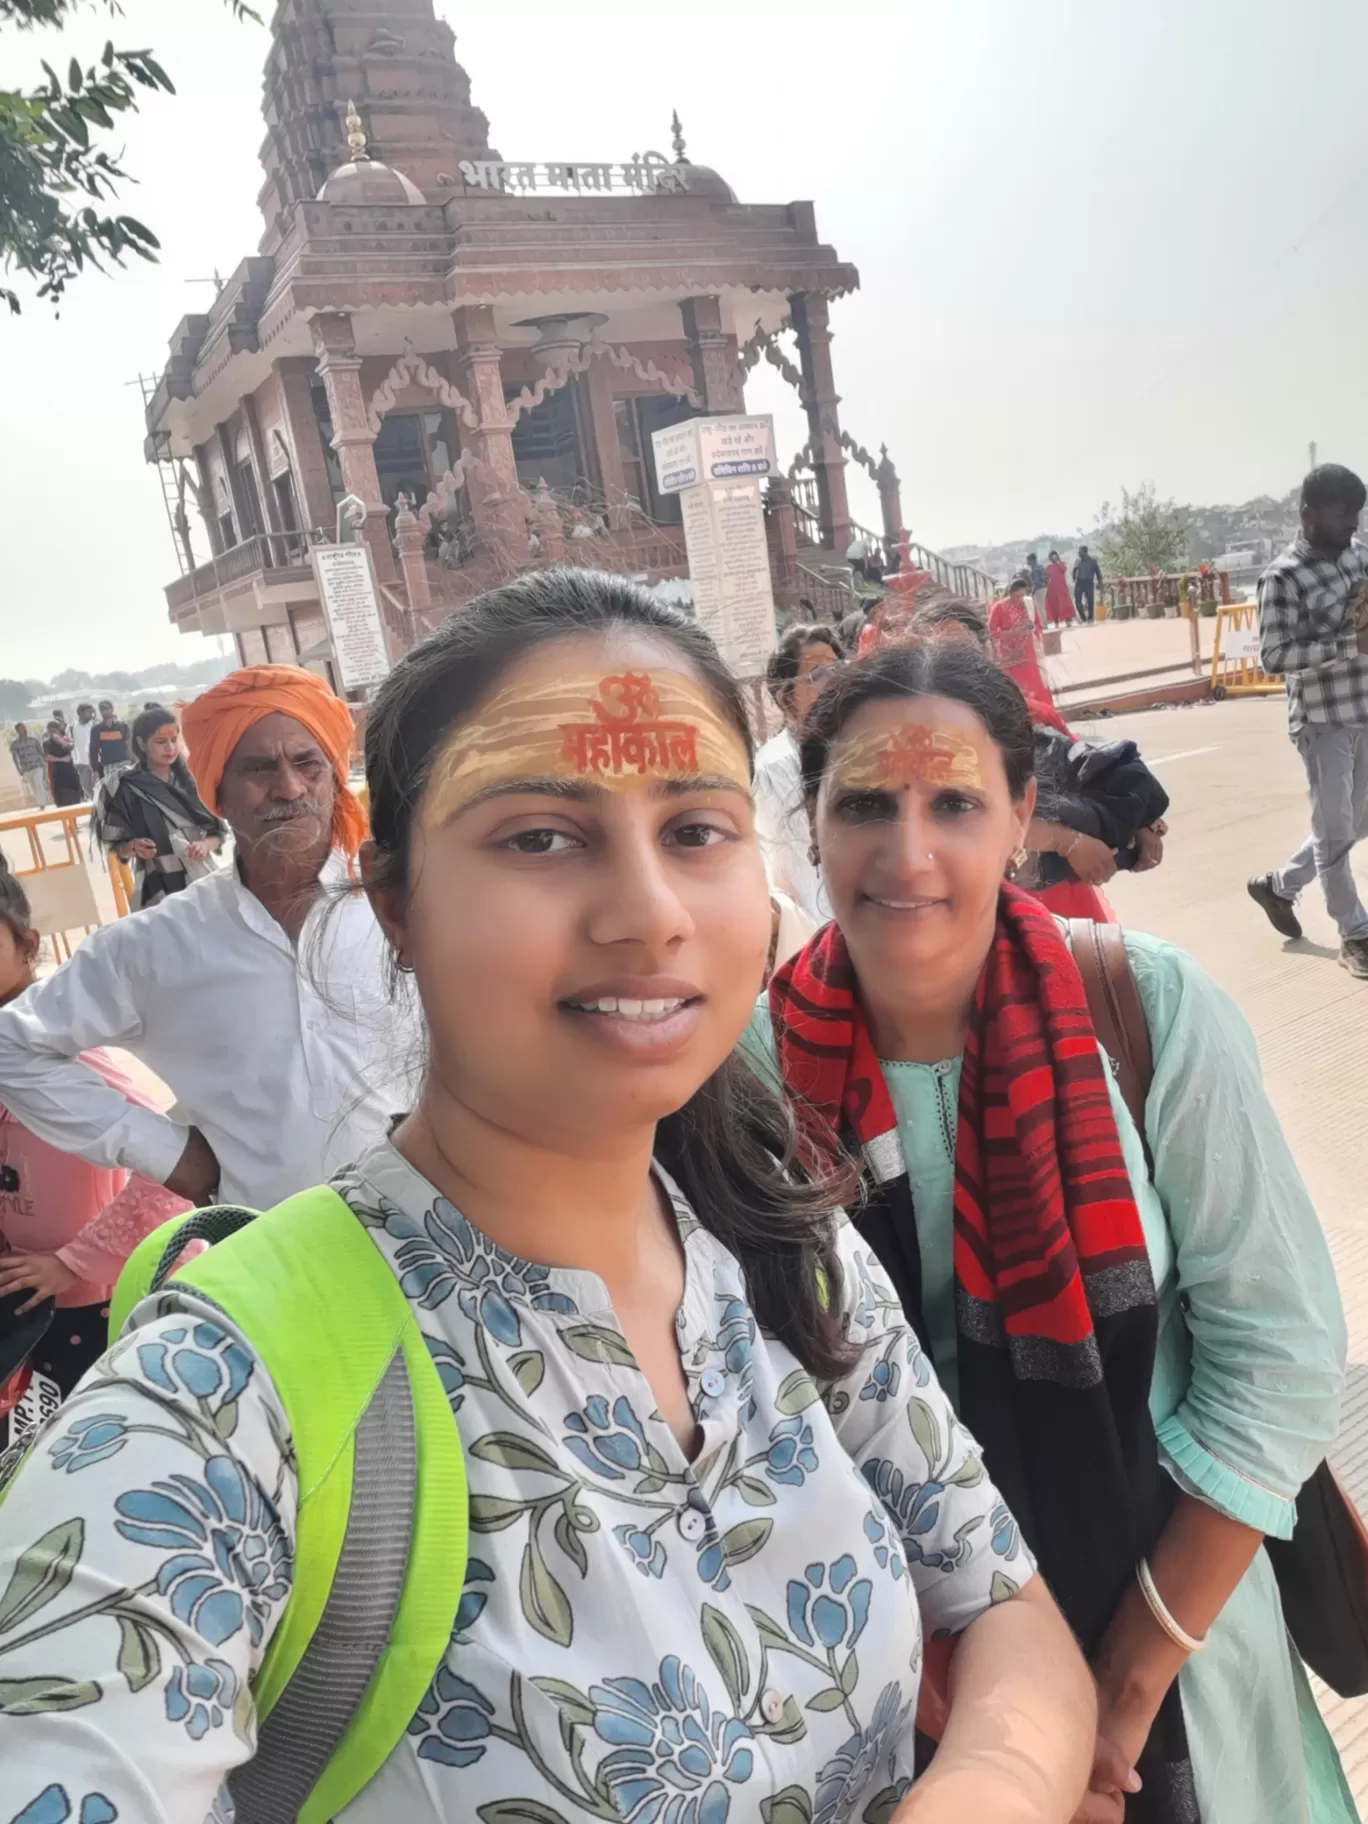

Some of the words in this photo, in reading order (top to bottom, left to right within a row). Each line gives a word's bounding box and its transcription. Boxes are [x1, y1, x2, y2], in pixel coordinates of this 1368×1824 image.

[458, 159, 537, 191] भारत
[545, 161, 613, 192] माता
[619, 150, 691, 194] मंदिर
[557, 721, 700, 774] महाकाल
